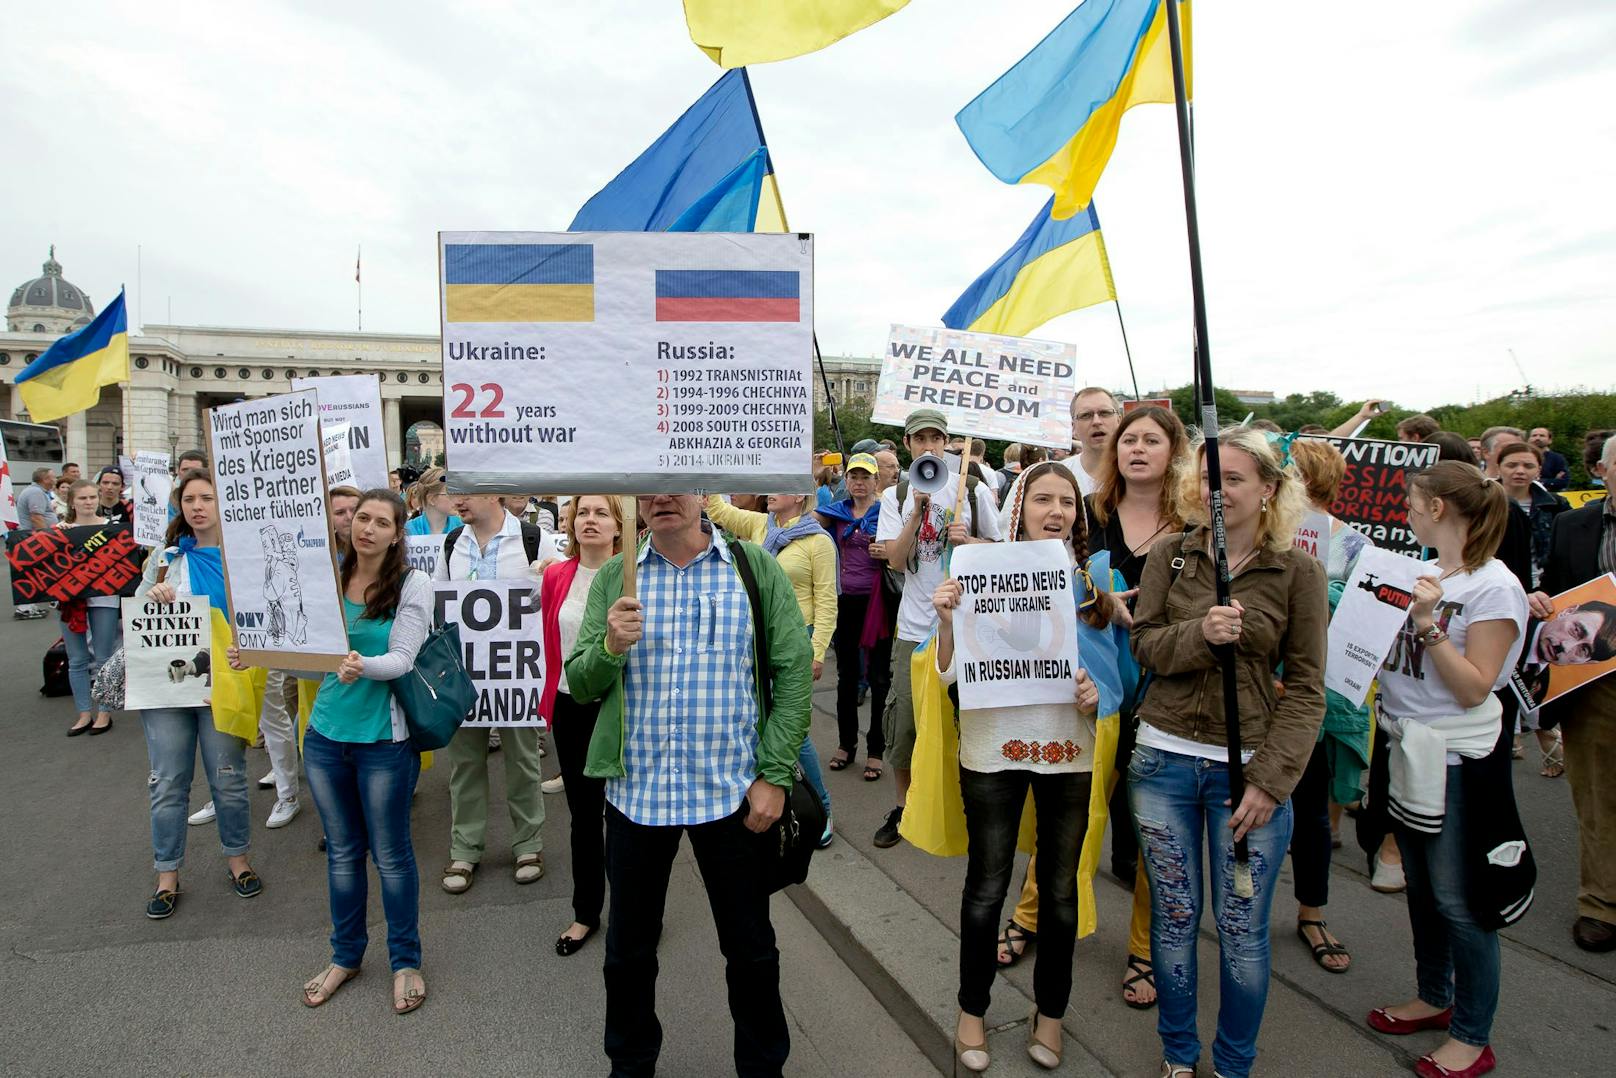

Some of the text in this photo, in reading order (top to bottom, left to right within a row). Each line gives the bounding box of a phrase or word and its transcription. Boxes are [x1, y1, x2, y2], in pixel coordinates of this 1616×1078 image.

[449, 341, 546, 360] Ukraine:
[657, 341, 735, 360] Russia:
[891, 342, 1073, 378] WE ALL NEED
[657, 369, 669, 383] 1)
[673, 369, 703, 381] 1992
[912, 365, 1038, 396] PEACE and
[451, 383, 557, 422] 22 years
[657, 386, 807, 400] 2) 1994-1996 CHECHNYA
[904, 384, 1040, 418] FREEDOM
[212, 398, 312, 432] Wird man sich
[657, 403, 807, 417] 3) 1999-2009 CHECHNYA
[220, 423, 304, 450] mit Sponsor
[450, 422, 577, 443] without war
[657, 420, 804, 434] 4) 2008 SOUTH OSSETIA,
[669, 436, 802, 449] ABKHAZIA & GEORGIA
[218, 448, 317, 476] des Krieges
[674, 454, 704, 466] 2014
[707, 453, 761, 466] UKRAINE
[225, 475, 317, 501] als Partner
[224, 497, 322, 522] sicher fühlen?
[4, 524, 69, 571] KEIN
[84, 530, 108, 552] MIT
[12, 544, 88, 599] DIALOG
[91, 558, 140, 595] TEN
[957, 569, 1066, 594] STOP FAKED NEWS
[143, 601, 191, 615] GELD
[974, 596, 1051, 614] ABOUT UKRAINE
[1380, 587, 1411, 607] PUTIN
[132, 616, 203, 631] STINKT
[141, 633, 200, 647] NICHT
[239, 633, 267, 648] OMV
[465, 641, 542, 680] LER
[964, 659, 1072, 683] IN RUSSIAN MEDIA
